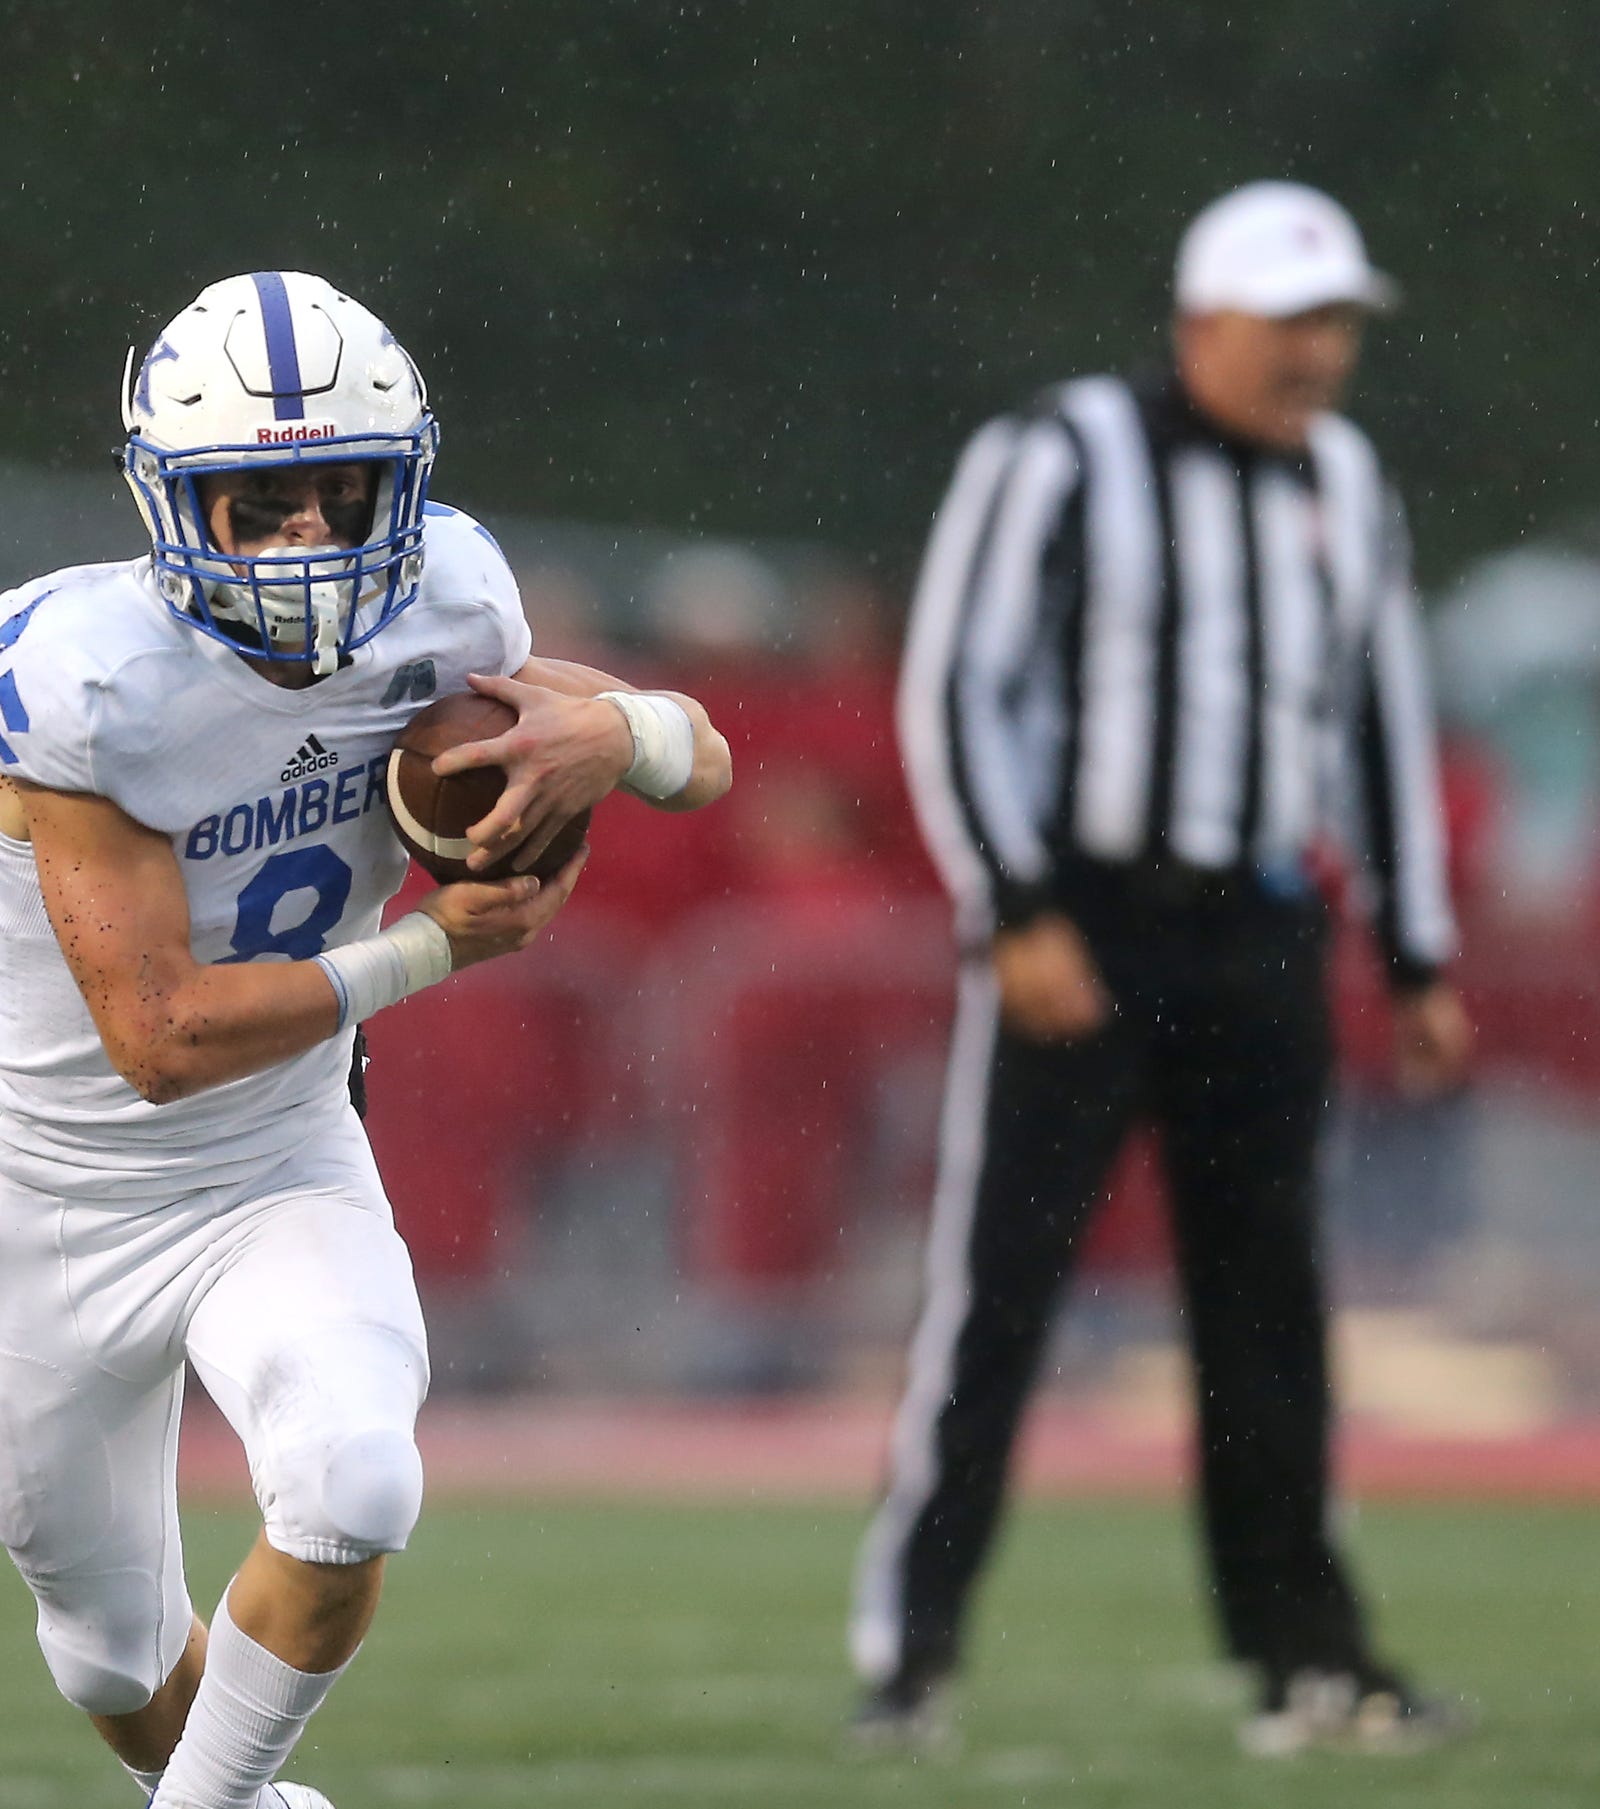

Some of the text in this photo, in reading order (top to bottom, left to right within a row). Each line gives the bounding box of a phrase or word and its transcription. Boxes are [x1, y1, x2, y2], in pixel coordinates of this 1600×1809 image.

[257, 425, 335, 444] Riddell
[280, 751, 339, 783] adidas
[220, 843, 353, 963] 8
